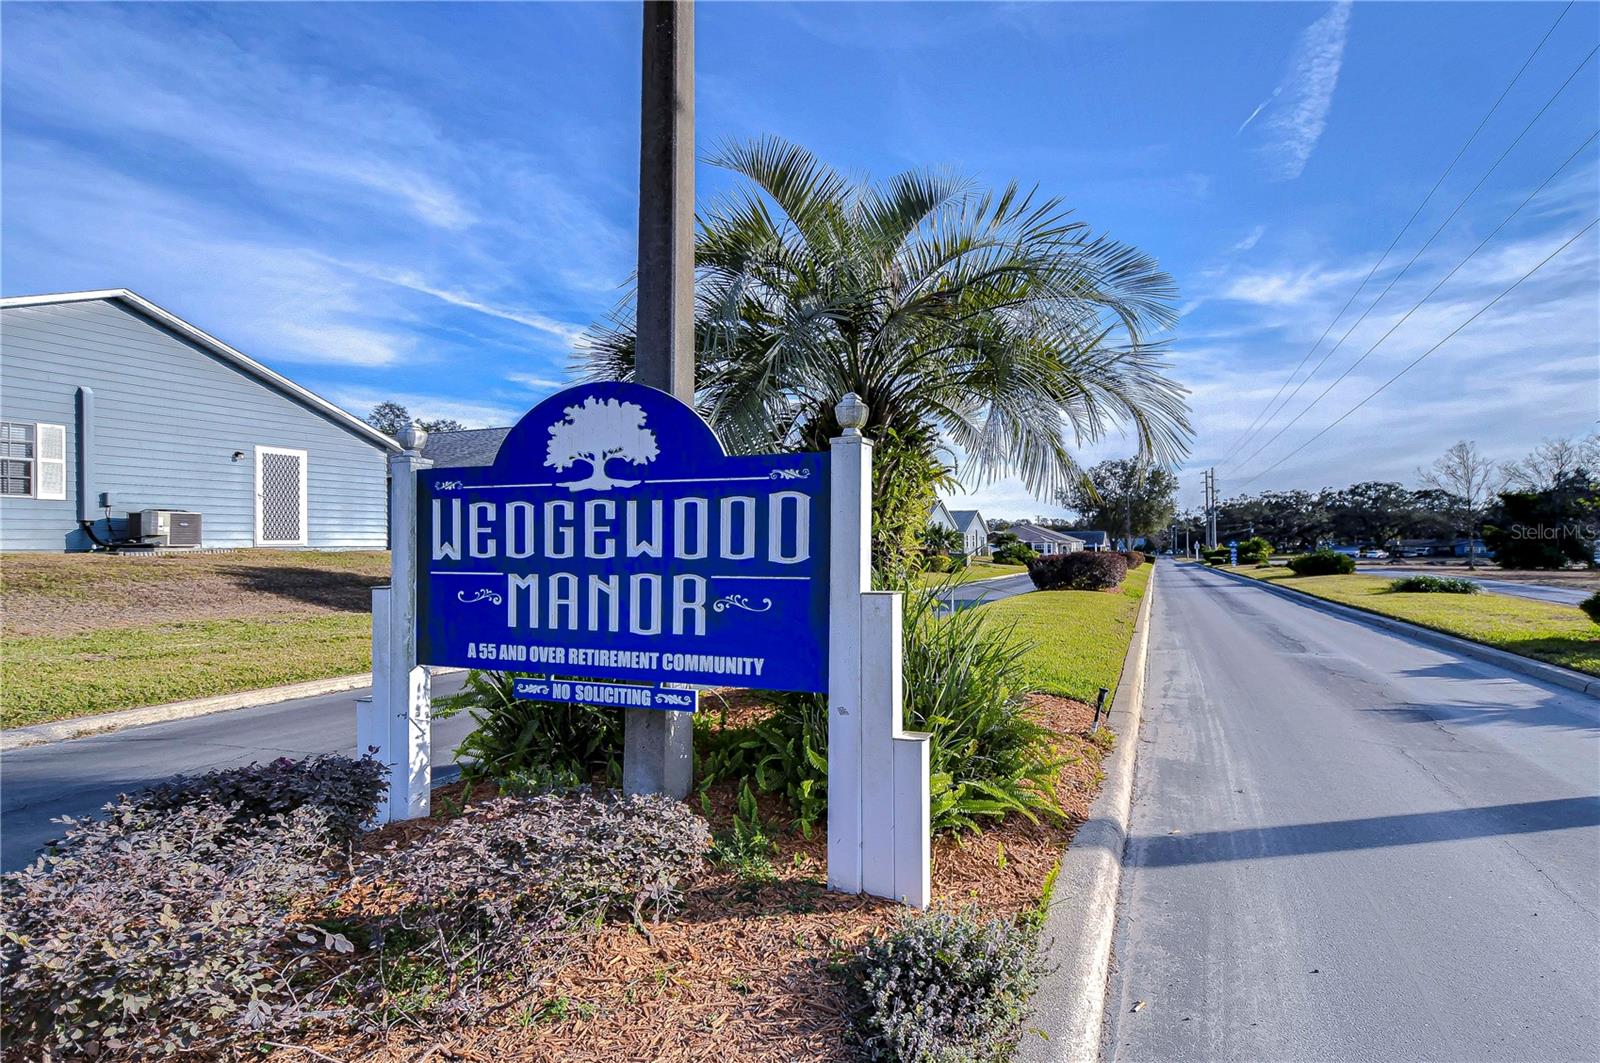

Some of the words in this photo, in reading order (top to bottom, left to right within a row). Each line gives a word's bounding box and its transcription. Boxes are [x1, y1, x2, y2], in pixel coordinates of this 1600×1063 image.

[431, 490, 811, 564] WEDGEWOOD
[507, 572, 707, 636] MANOR
[467, 642, 477, 659] A
[479, 643, 497, 660] 55
[499, 644, 527, 662] AND
[529, 646, 565, 664] OVER
[568, 648, 660, 670] RETIREMENT
[662, 653, 765, 676] COMMUNITY
[552, 683, 571, 700] NO
[575, 685, 651, 707] SOLICITING
